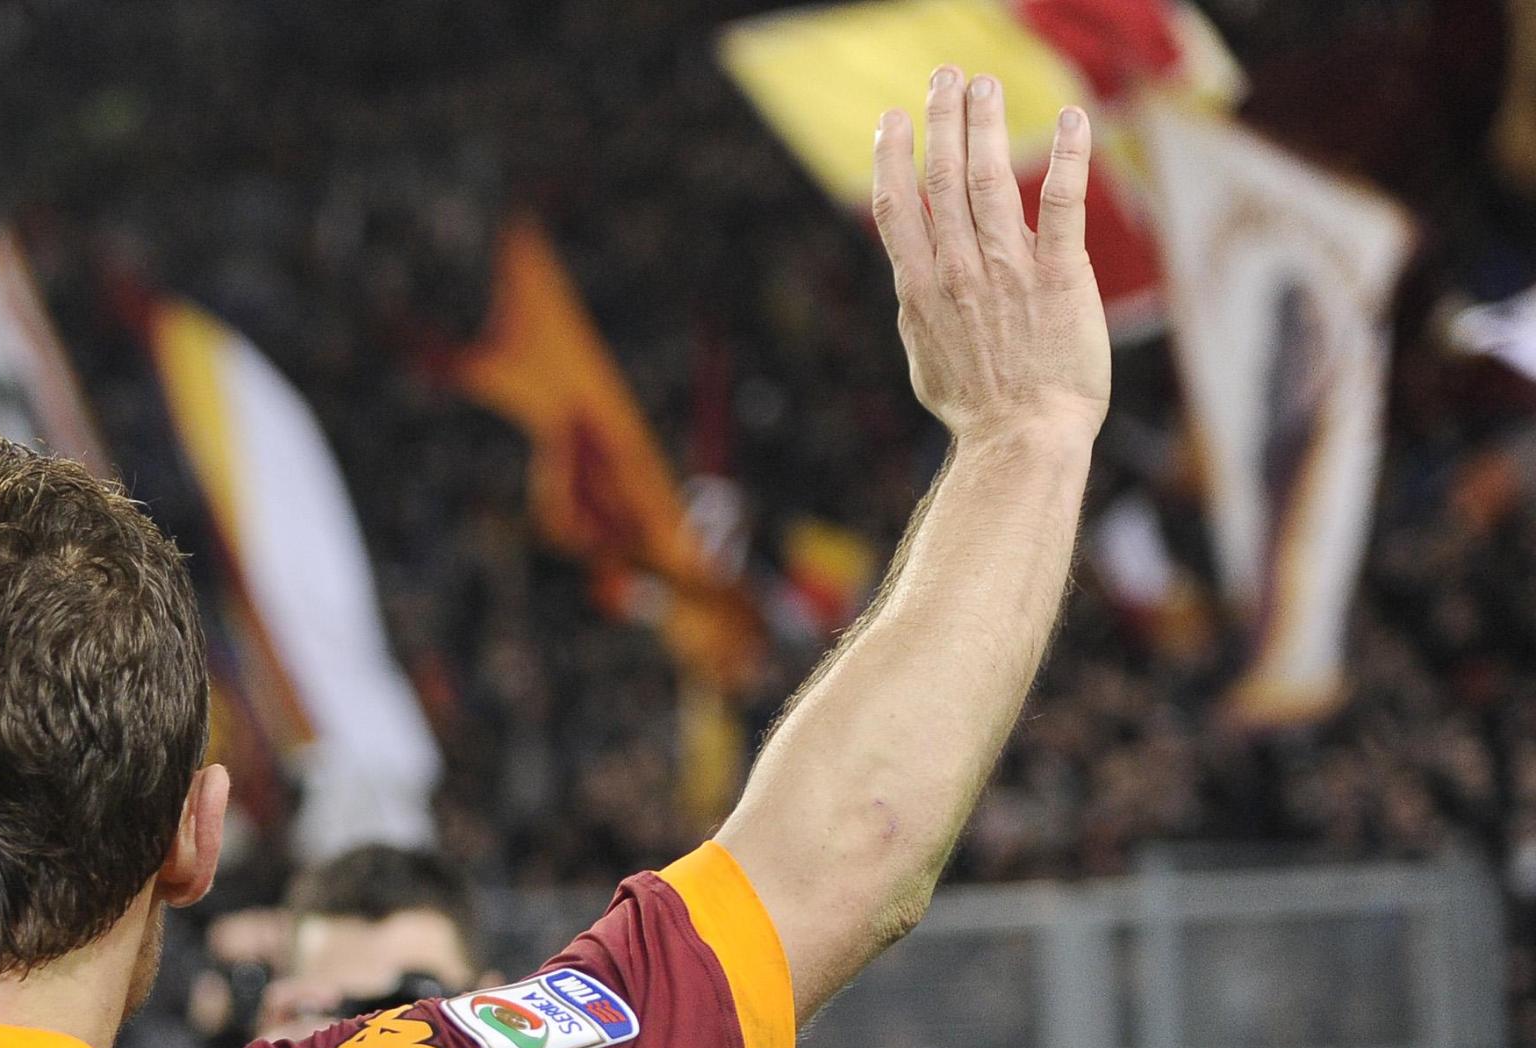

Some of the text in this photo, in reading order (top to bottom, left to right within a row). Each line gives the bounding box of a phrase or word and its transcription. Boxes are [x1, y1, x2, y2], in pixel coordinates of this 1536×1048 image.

[553, 976, 601, 1004] TIM
[521, 992, 583, 1035] SERIE A
